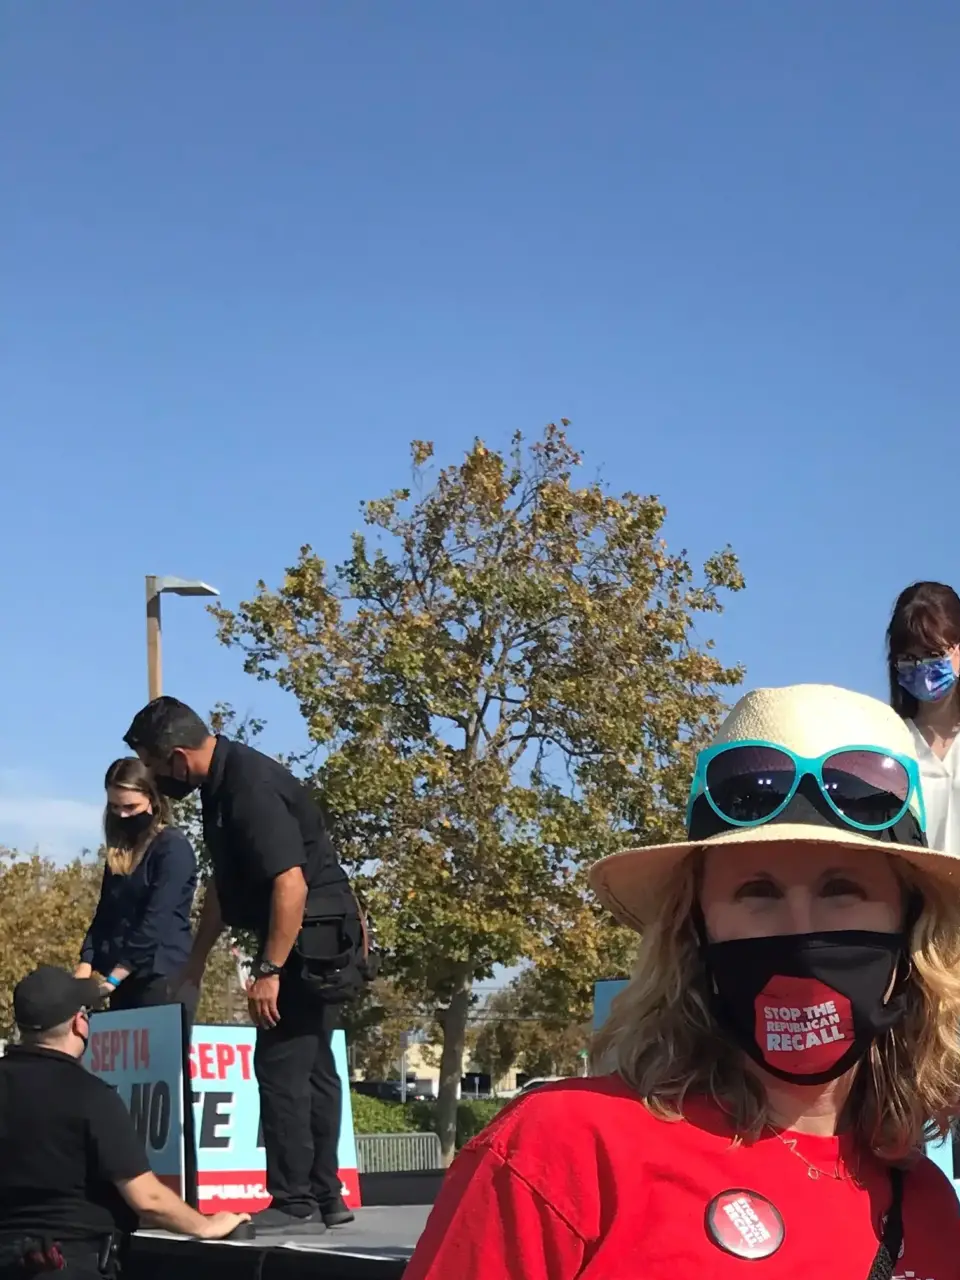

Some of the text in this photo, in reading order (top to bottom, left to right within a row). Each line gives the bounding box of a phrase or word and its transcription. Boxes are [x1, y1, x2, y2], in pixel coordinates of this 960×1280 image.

[764, 1001, 837, 1021] STOP THE
[766, 1014, 840, 1033] REPUBLICAN
[90, 1028, 150, 1073] SEPT 14
[767, 1026, 845, 1051] RECALL
[130, 1080, 171, 1150] NO
[736, 1198, 760, 1222] STOP
[722, 1204, 757, 1249] RECALL
